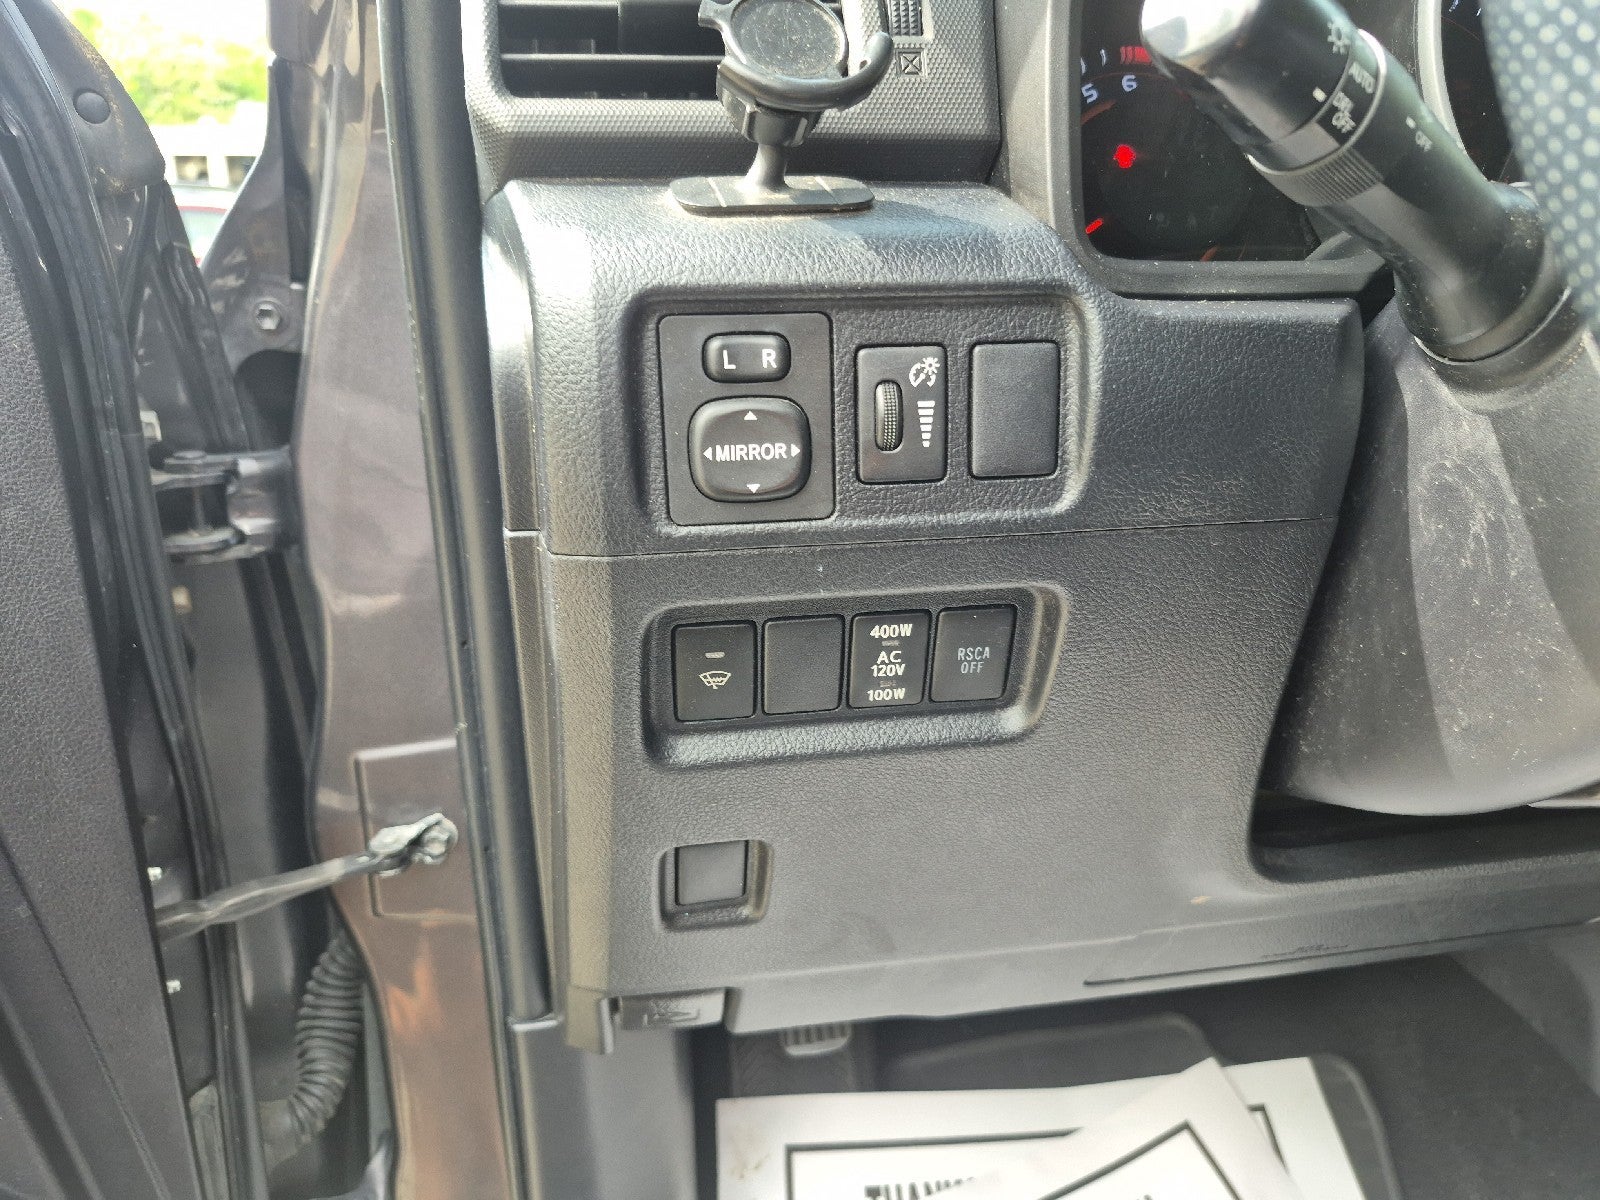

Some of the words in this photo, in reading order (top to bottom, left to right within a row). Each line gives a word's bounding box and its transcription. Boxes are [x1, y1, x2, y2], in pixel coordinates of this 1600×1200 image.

[1121, 73, 1138, 93] 6
[1080, 82, 1099, 104] 5
[1331, 111, 1357, 134] OFF
[722, 349, 737, 370] L
[761, 348, 778, 369] R
[715, 442, 788, 462] MIRROR
[869, 623, 913, 639] 400W
[876, 650, 902, 665] AC
[957, 646, 990, 661] RSCA
[870, 663, 906, 678] 120V
[960, 661, 985, 674] OFF
[866, 687, 906, 702] 100W
